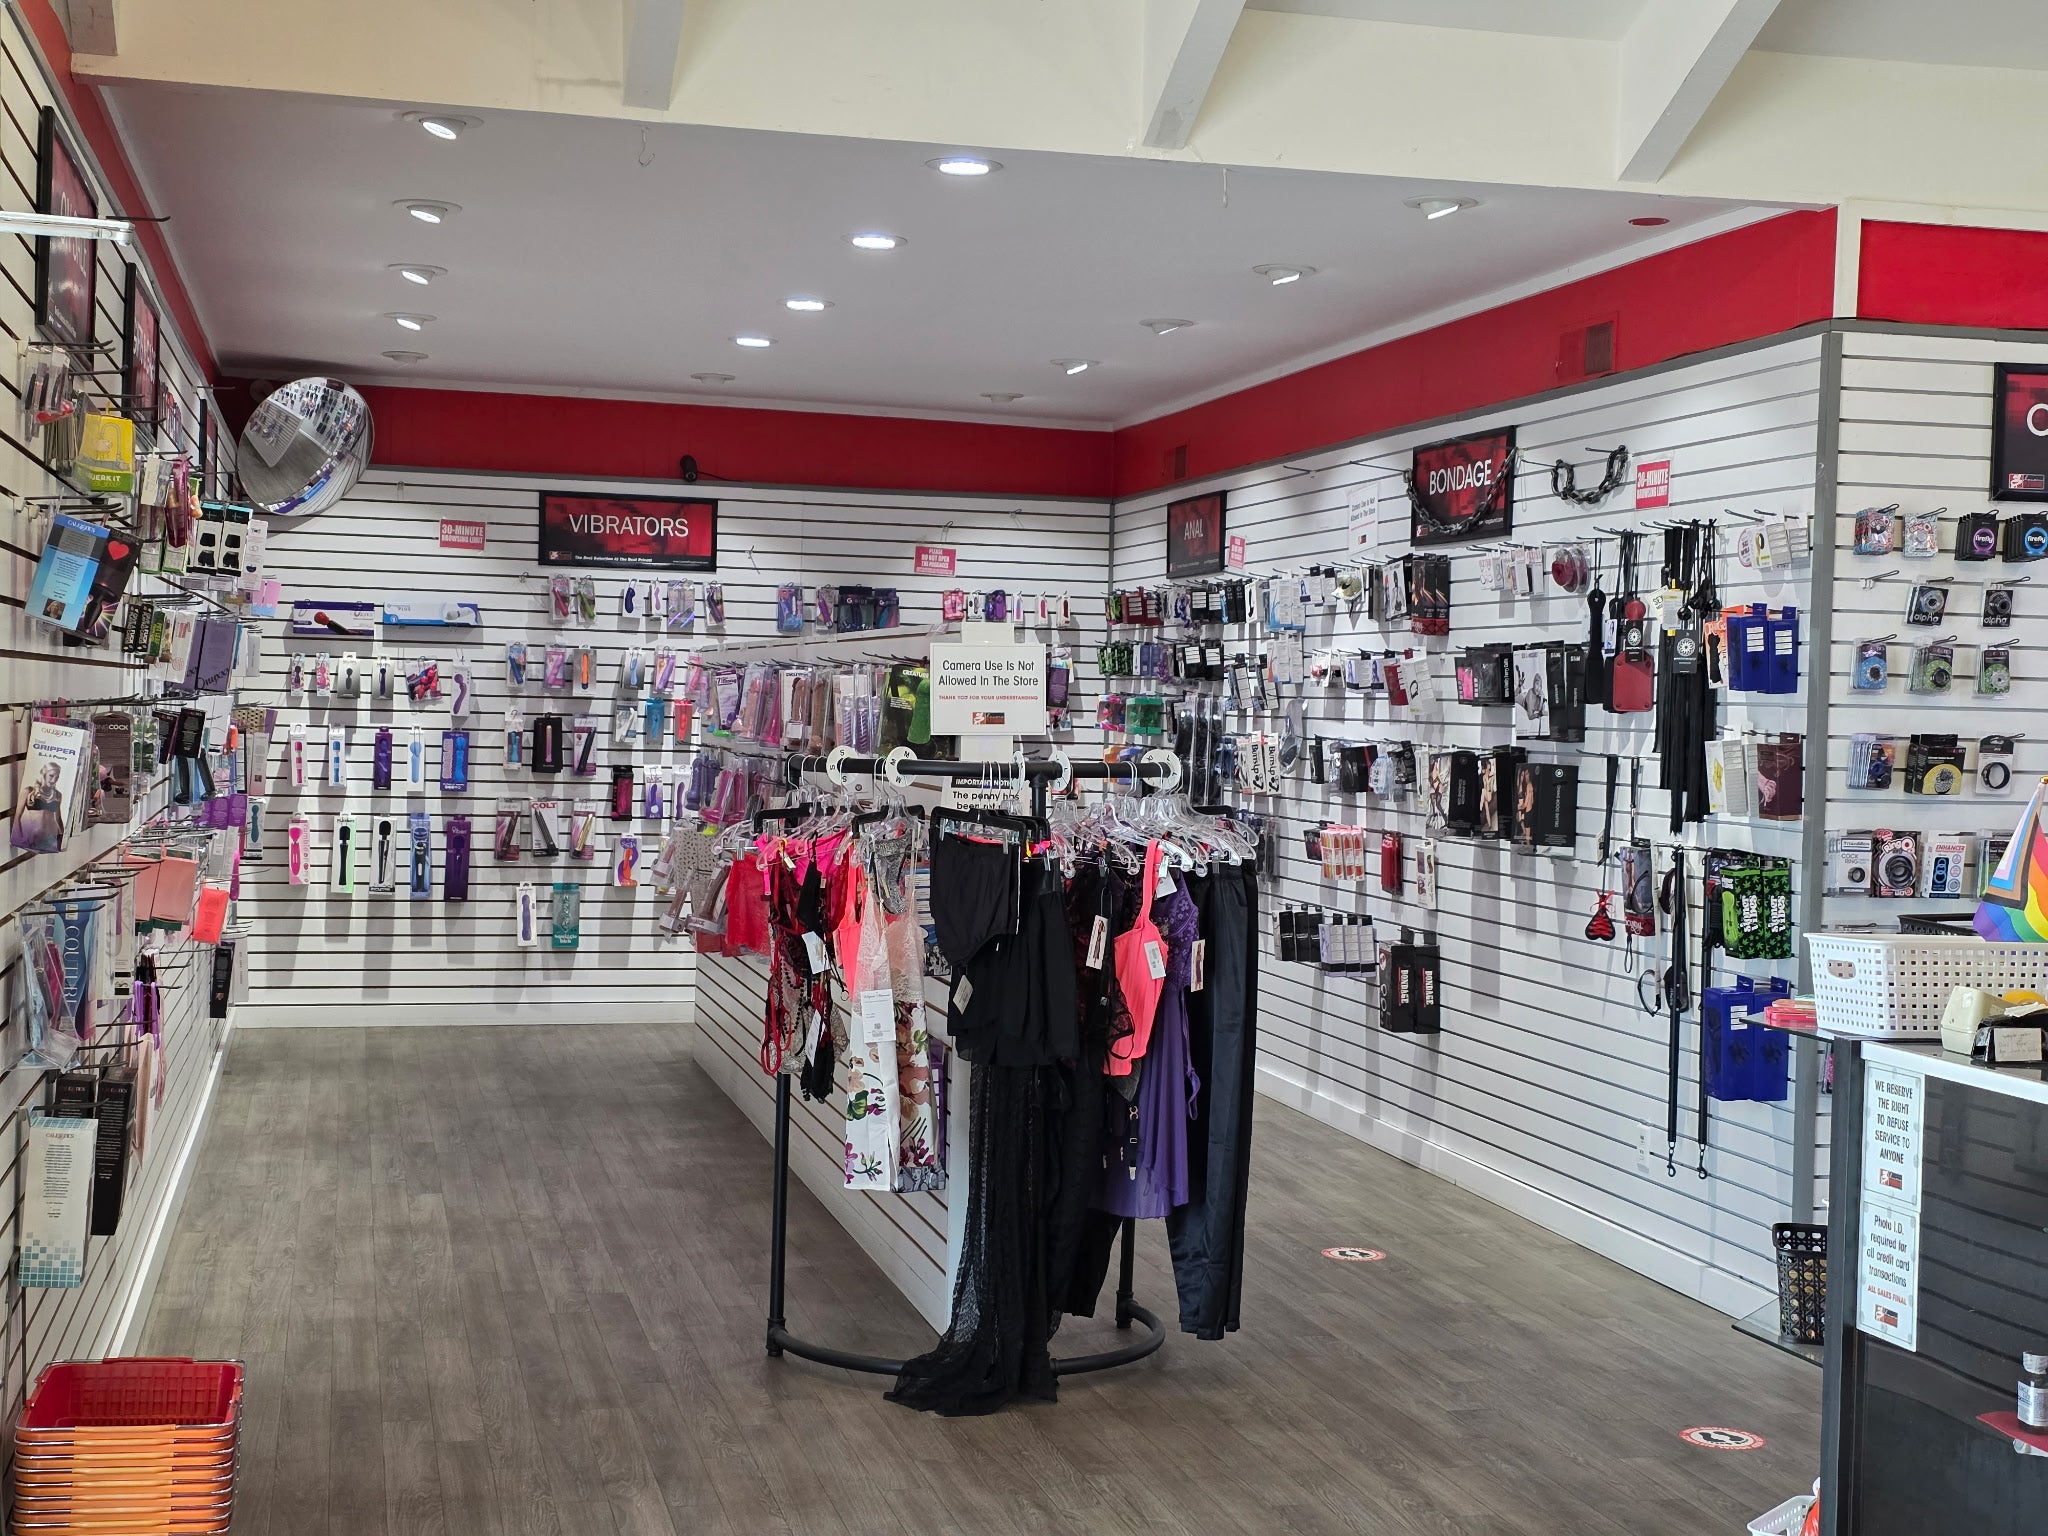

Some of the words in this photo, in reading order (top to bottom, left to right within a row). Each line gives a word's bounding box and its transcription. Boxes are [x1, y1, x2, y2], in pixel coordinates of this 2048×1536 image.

[1430, 459, 1491, 495] BONDAGE
[442, 524, 484, 536] 30-MINUTE
[569, 514, 688, 537] VIBRATORS
[1184, 518, 1203, 540] ANAL
[1975, 535, 1994, 544] firefly
[2028, 535, 2046, 544] firefly
[1914, 612, 1939, 623] alpha
[1984, 614, 2008, 625] alpha
[943, 660, 980, 670] Camera
[984, 660, 1003, 670] Use
[1006, 660, 1014, 670] Is
[1018, 660, 1034, 670] Not
[939, 675, 976, 686] Allowed
[981, 676, 988, 686] In
[993, 676, 1009, 686] The
[1014, 676, 1038, 686] Store
[33, 744, 76, 755] GRIPPER
[953, 791, 968, 799] The
[972, 792, 1000, 802] penny
[1401, 970, 1409, 1004] BONDAGE
[1425, 971, 1434, 1005] BONDAGE
[1875, 1080, 1884, 1091] WE
[1886, 1082, 1913, 1099] RESERVE
[1878, 1097, 1889, 1110] THE
[1891, 1100, 1909, 1115] RIGHT
[1877, 1114, 1884, 1125] TO
[1887, 1115, 1909, 1132] REFUSE
[1875, 1130, 1900, 1146] SERVICE
[1902, 1137, 1910, 1149] TO
[1880, 1148, 1904, 1164] ANYONE
[1874, 1215, 1892, 1231] Photo
[1894, 1221, 1904, 1235] I.D.
[1871, 1233, 1896, 1249] required
[1898, 1240, 1907, 1253] for
[1877, 1251, 1894, 1265] credit
[1896, 1258, 1910, 1271] card
[1869, 1264, 1906, 1287] transactions
[1868, 1285, 1876, 1294] ALL
[1878, 1287, 1891, 1300] SALES
[1892, 1294, 1907, 1305] FINAL
